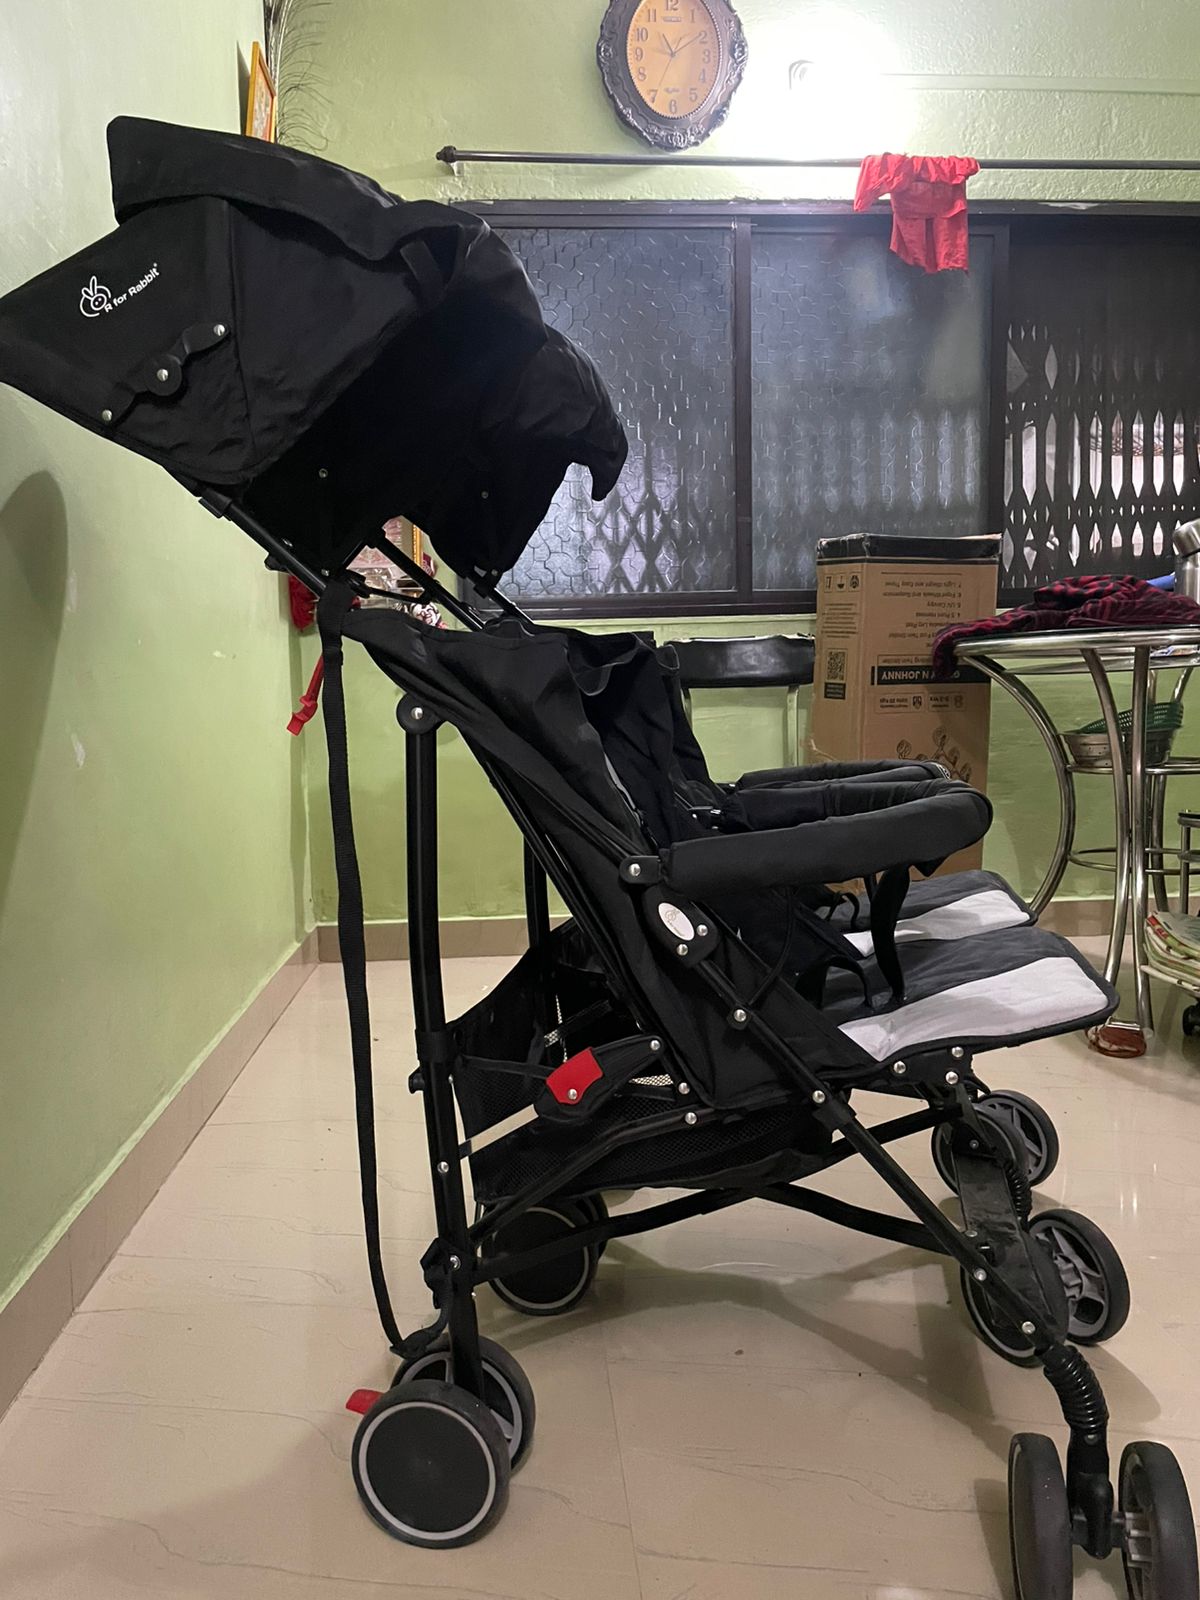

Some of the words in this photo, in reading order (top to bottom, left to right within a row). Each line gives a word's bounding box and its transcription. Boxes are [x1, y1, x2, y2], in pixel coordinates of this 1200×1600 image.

[665, 0, 678, 11] 12
[648, 8, 657, 22] 11
[690, 9, 695, 23] 1
[636, 27, 648, 42] 10
[699, 31, 707, 44] 2
[635, 47, 643, 61] 9
[703, 49, 710, 63] 3
[638, 66, 646, 81] 8
[698, 69, 706, 83] 4
[648, 89, 658, 103] 7
[689, 88, 697, 102] 5
[669, 99, 677, 114] 6
[104, 303, 113, 313] R
[113, 293, 128, 307] for
[128, 267, 160, 296] Rabbit
[881, 671, 920, 680] JOHNNY
[922, 671, 929, 679] N
